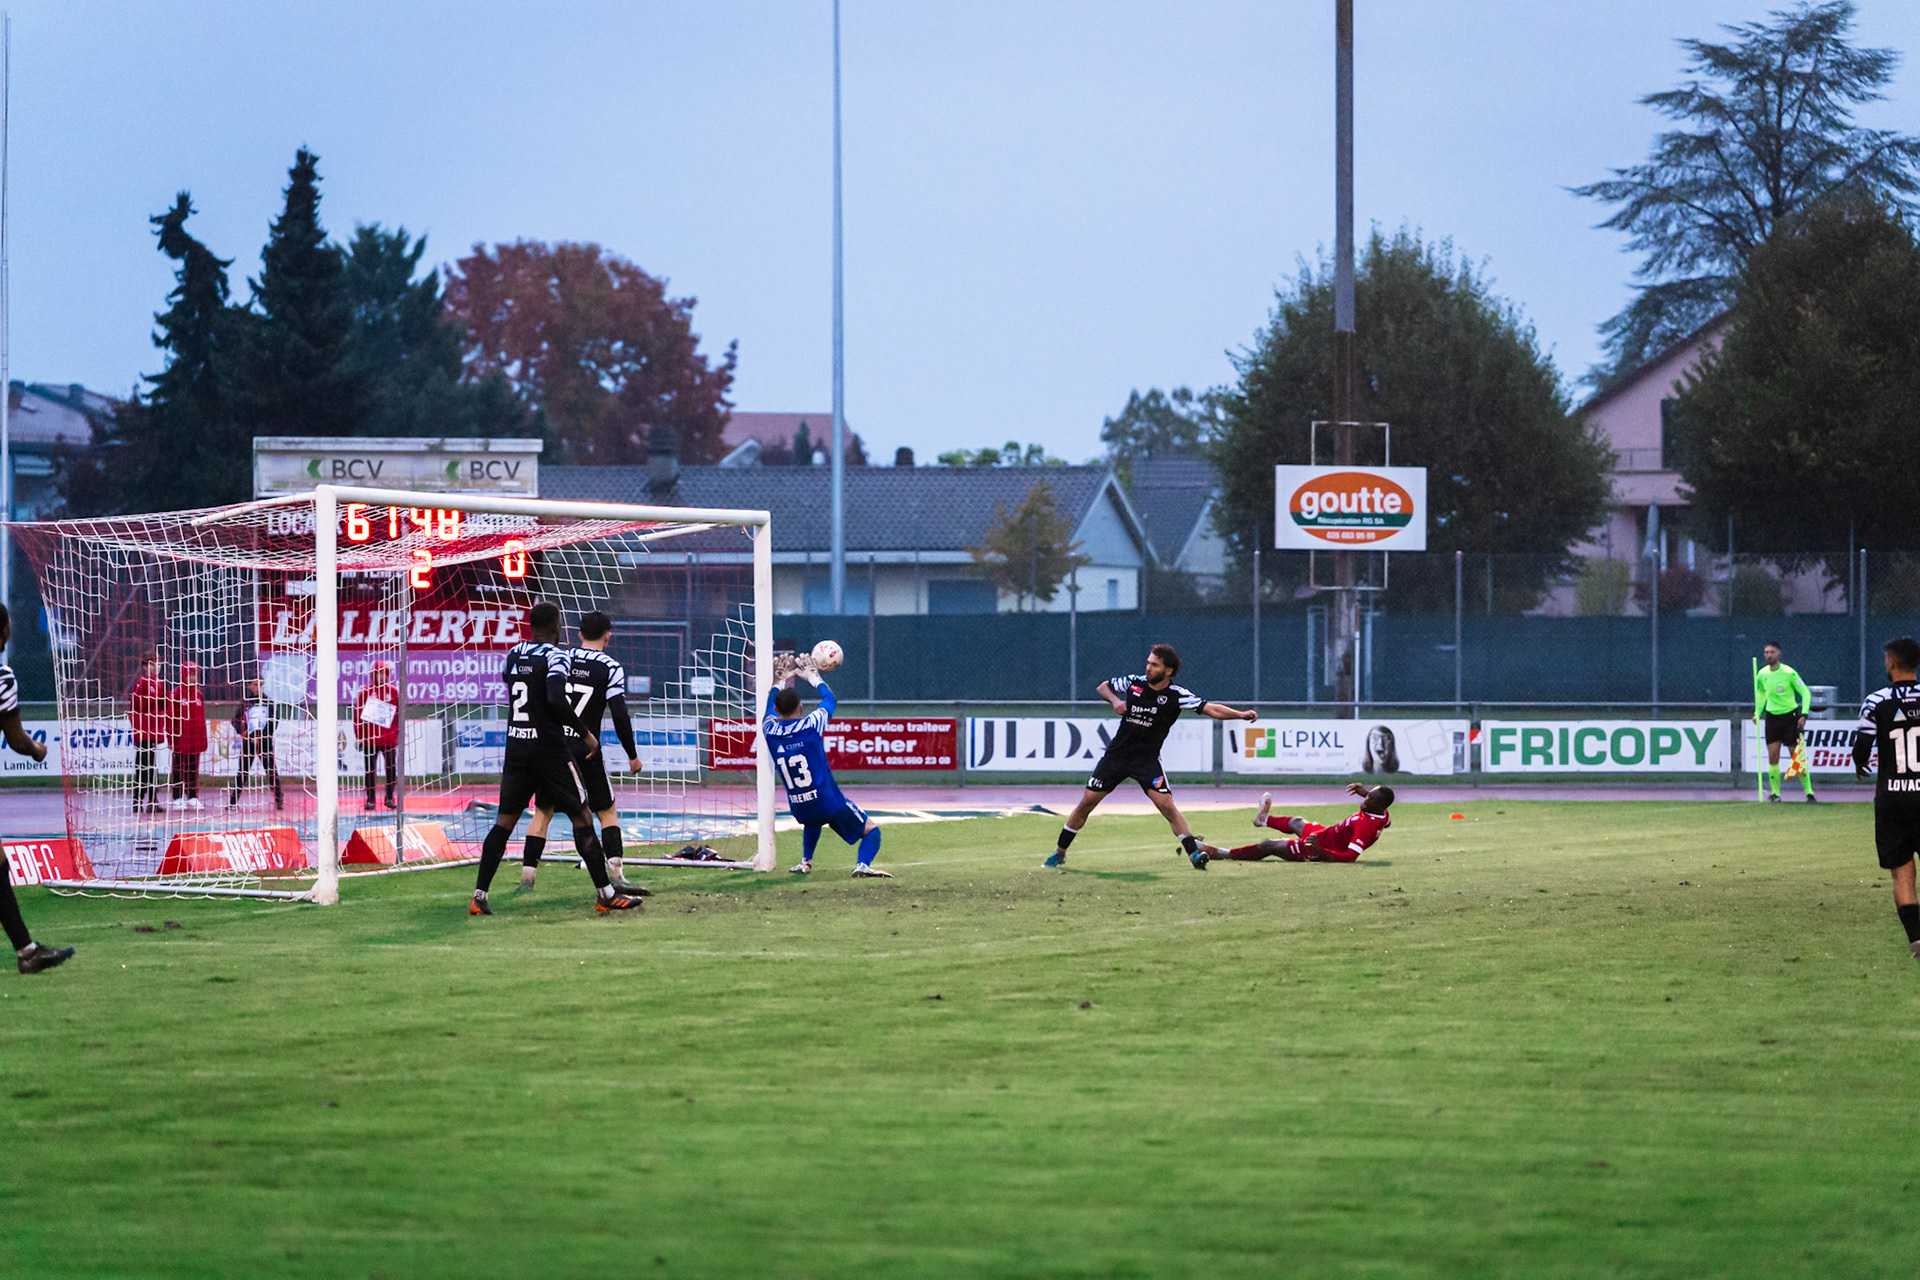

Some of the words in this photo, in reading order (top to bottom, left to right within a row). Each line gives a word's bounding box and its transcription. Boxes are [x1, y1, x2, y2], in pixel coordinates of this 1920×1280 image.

[332, 459, 384, 480] BCV
[470, 460, 520, 481] BCV
[1300, 486, 1402, 520] goutte
[410, 549, 433, 588] 2
[503, 539, 526, 578] 0
[407, 682, 440, 700] 079
[445, 682, 478, 700] 899
[484, 682, 506, 700] 72
[512, 681, 530, 722] 2
[861, 721, 904, 732] Service
[907, 722, 951, 732] traiteur
[823, 736, 917, 753] Fischer
[1490, 727, 1719, 766] FRICOPY
[1889, 726, 1920, 774] 10
[4, 758, 48, 770] Lambert
[777, 754, 813, 791] 13
